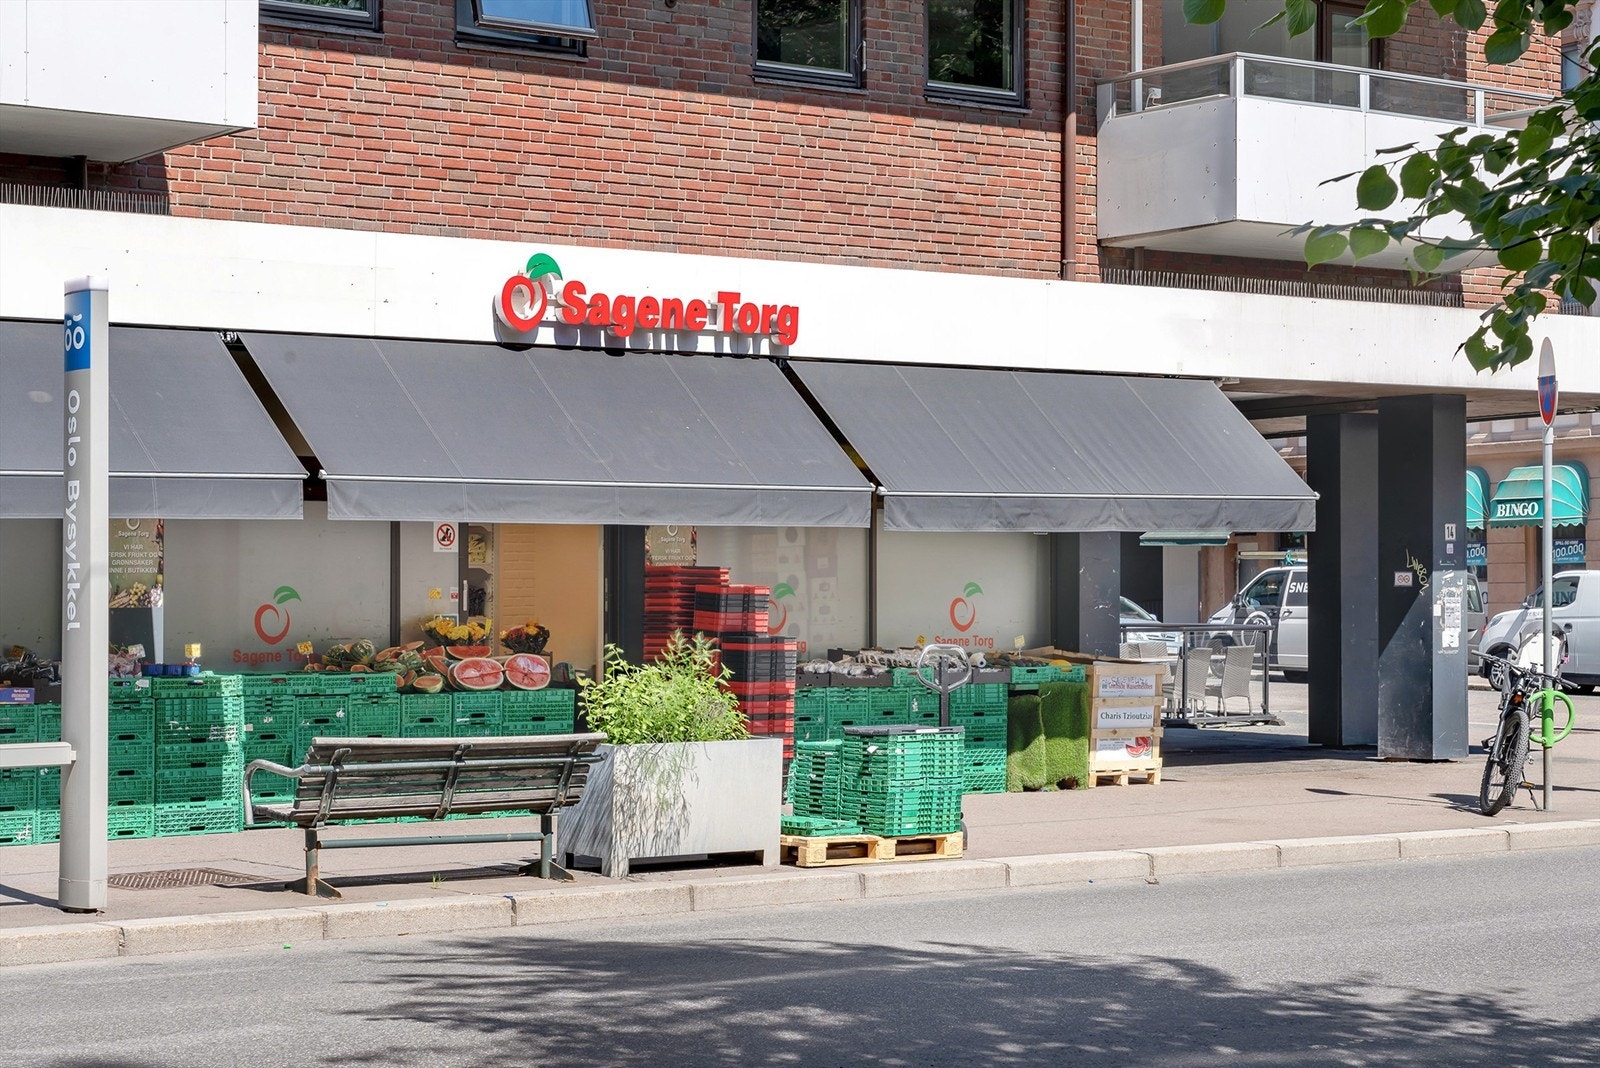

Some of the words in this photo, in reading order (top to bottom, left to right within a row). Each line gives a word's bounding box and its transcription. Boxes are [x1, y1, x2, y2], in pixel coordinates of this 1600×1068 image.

[562, 279, 709, 338] Sagene
[717, 291, 799, 346] Torg
[68, 389, 81, 467] Oslo
[1496, 502, 1539, 517] BINGO
[118, 530, 136, 538] Sagene
[138, 530, 150, 538] Torg
[1446, 526, 1454, 538] 14
[65, 479, 81, 631] Bysykkel
[1467, 546, 1486, 558] .000
[1552, 543, 1584, 558] 100.000
[973, 634, 994, 649] Torg
[232, 649, 282, 666] Sagene
[1100, 711, 1122, 720] Charis
